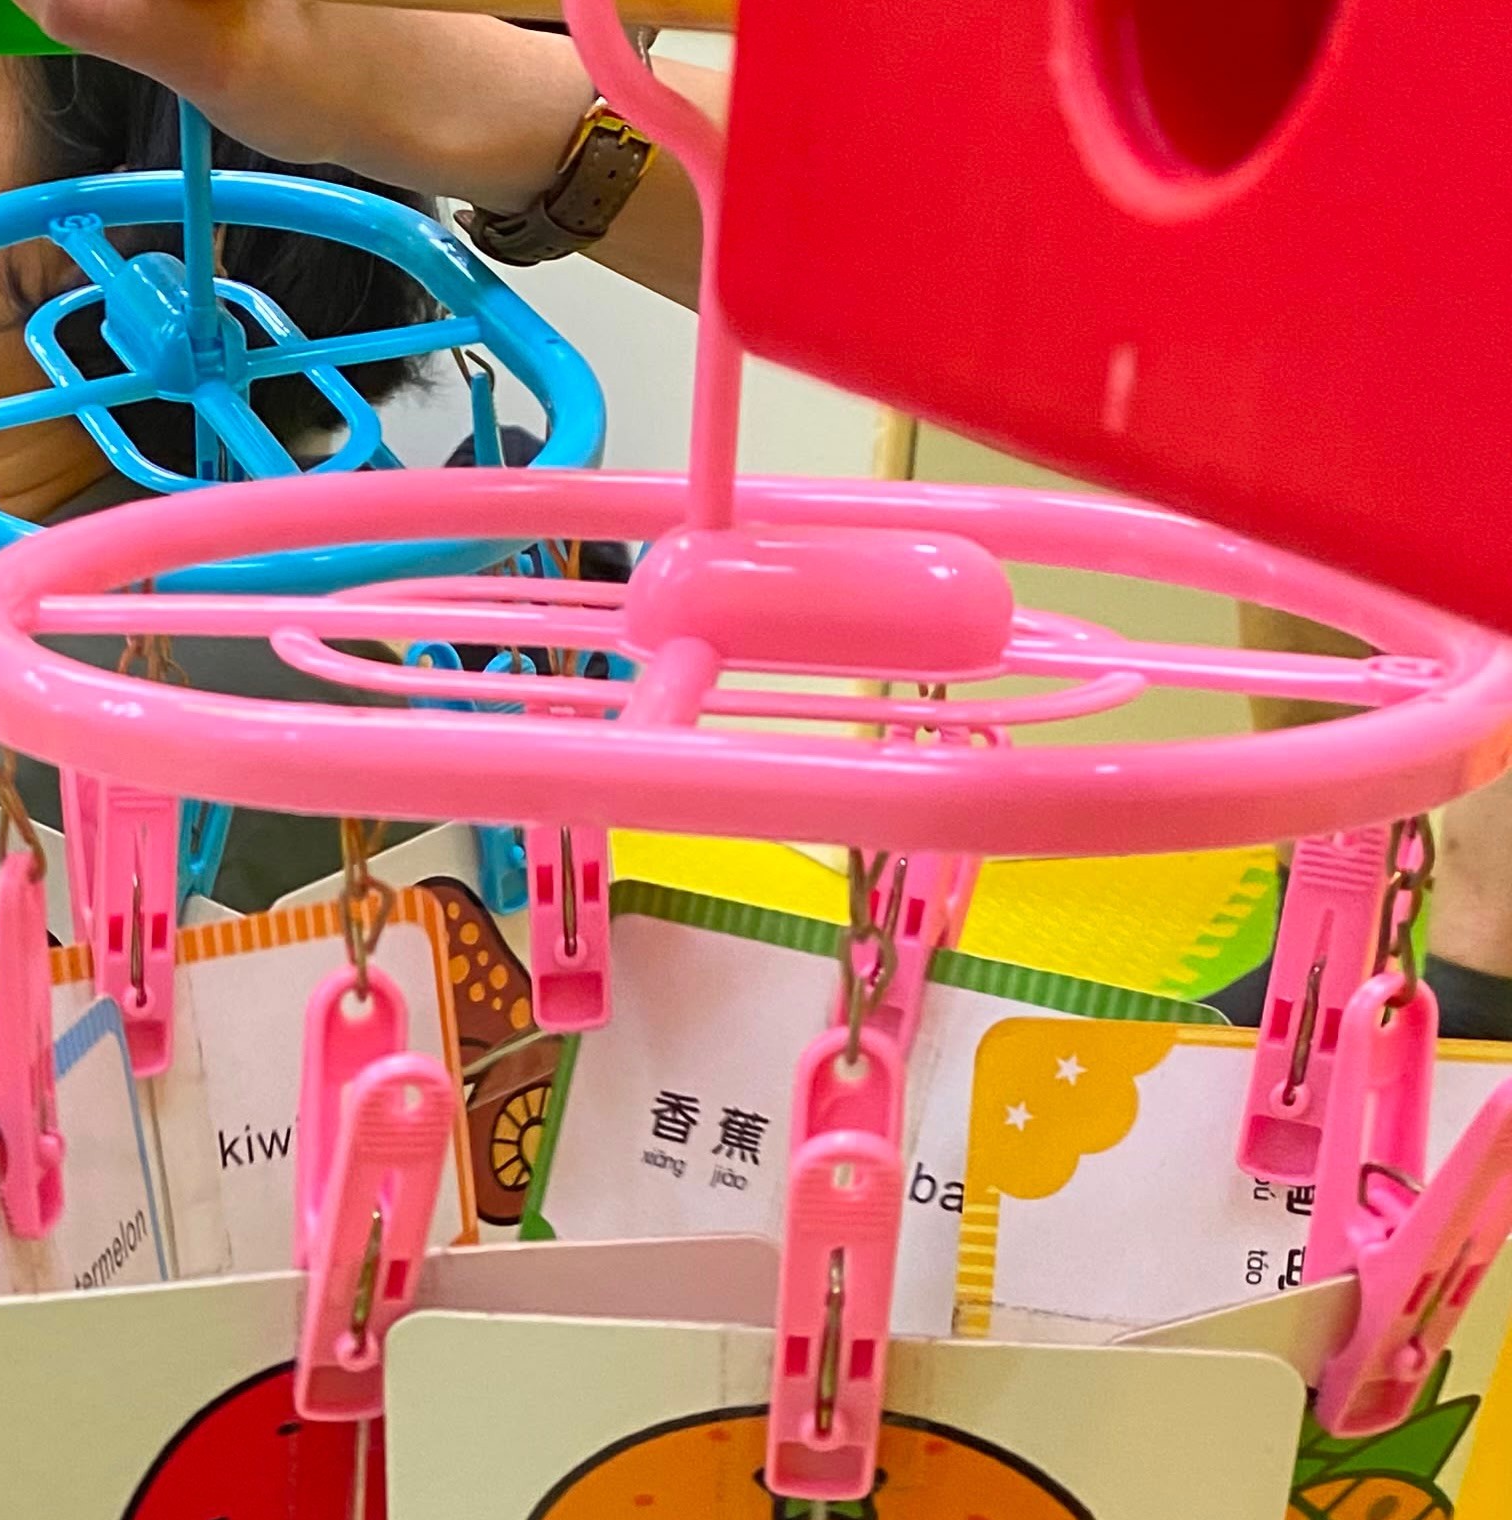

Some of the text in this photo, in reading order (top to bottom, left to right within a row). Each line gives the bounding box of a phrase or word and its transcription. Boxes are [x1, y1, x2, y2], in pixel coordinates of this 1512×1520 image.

[218, 1124, 300, 1169] kiw
[650, 1089, 771, 1167] 香蕉
[909, 1162, 965, 1213] ba
[73, 1208, 149, 1292] termelon
